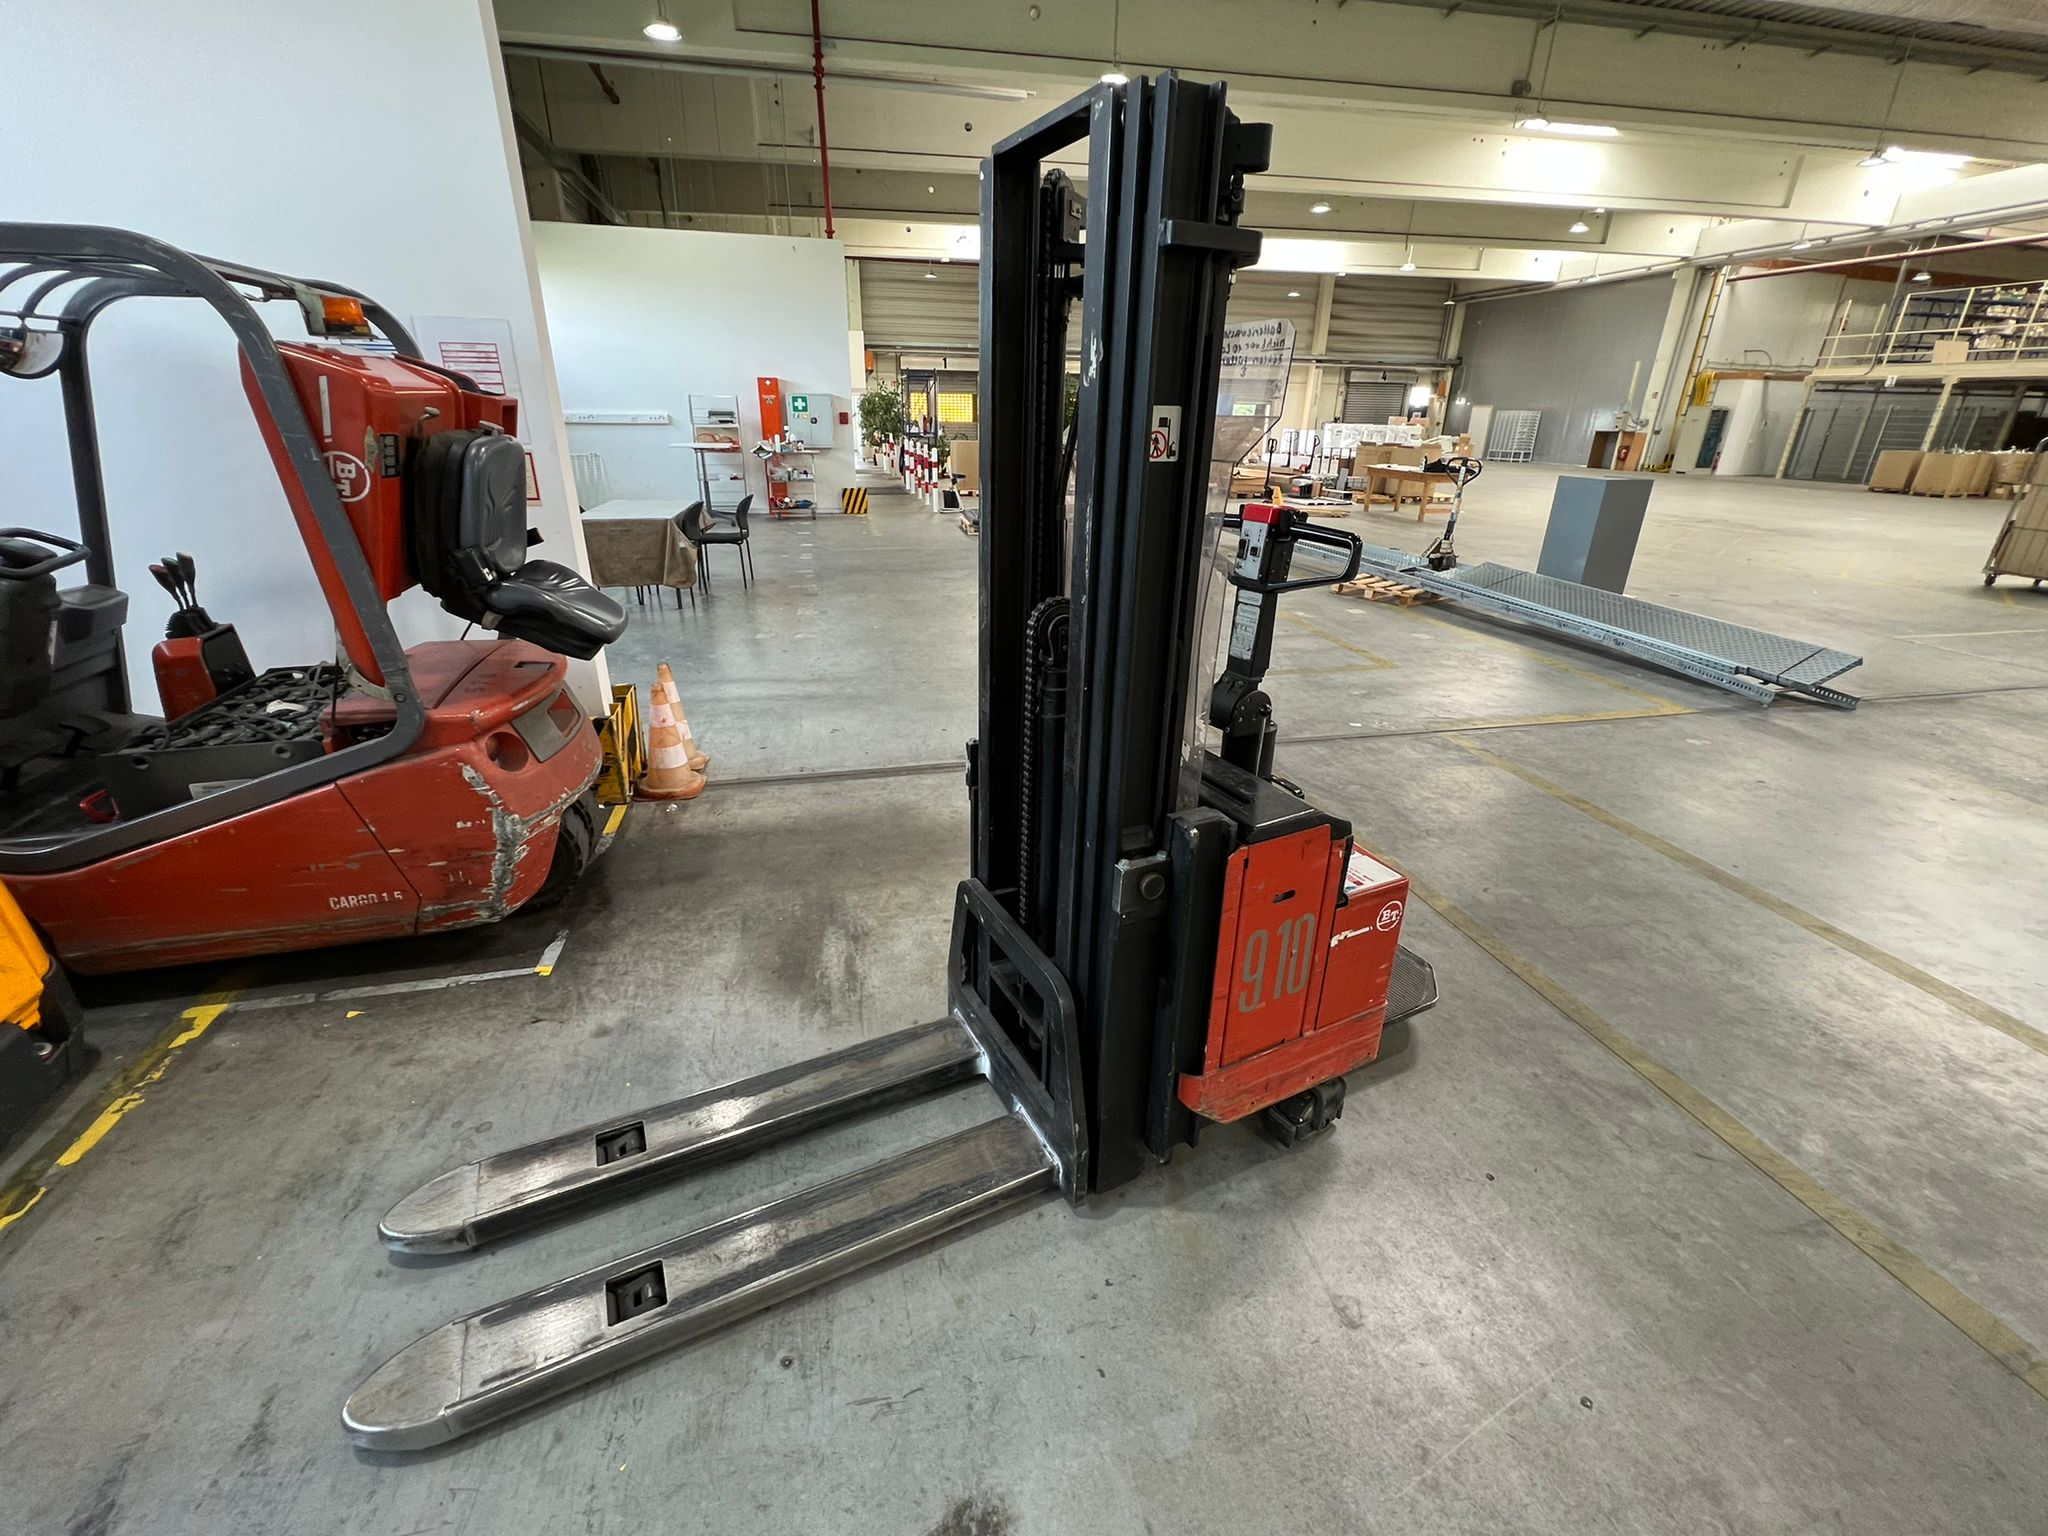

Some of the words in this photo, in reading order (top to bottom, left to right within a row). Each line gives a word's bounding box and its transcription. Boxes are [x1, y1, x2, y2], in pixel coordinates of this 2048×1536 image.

[942, 356, 948, 369] 1
[328, 893, 378, 910] CARGO
[1239, 911, 1316, 1014] 910
